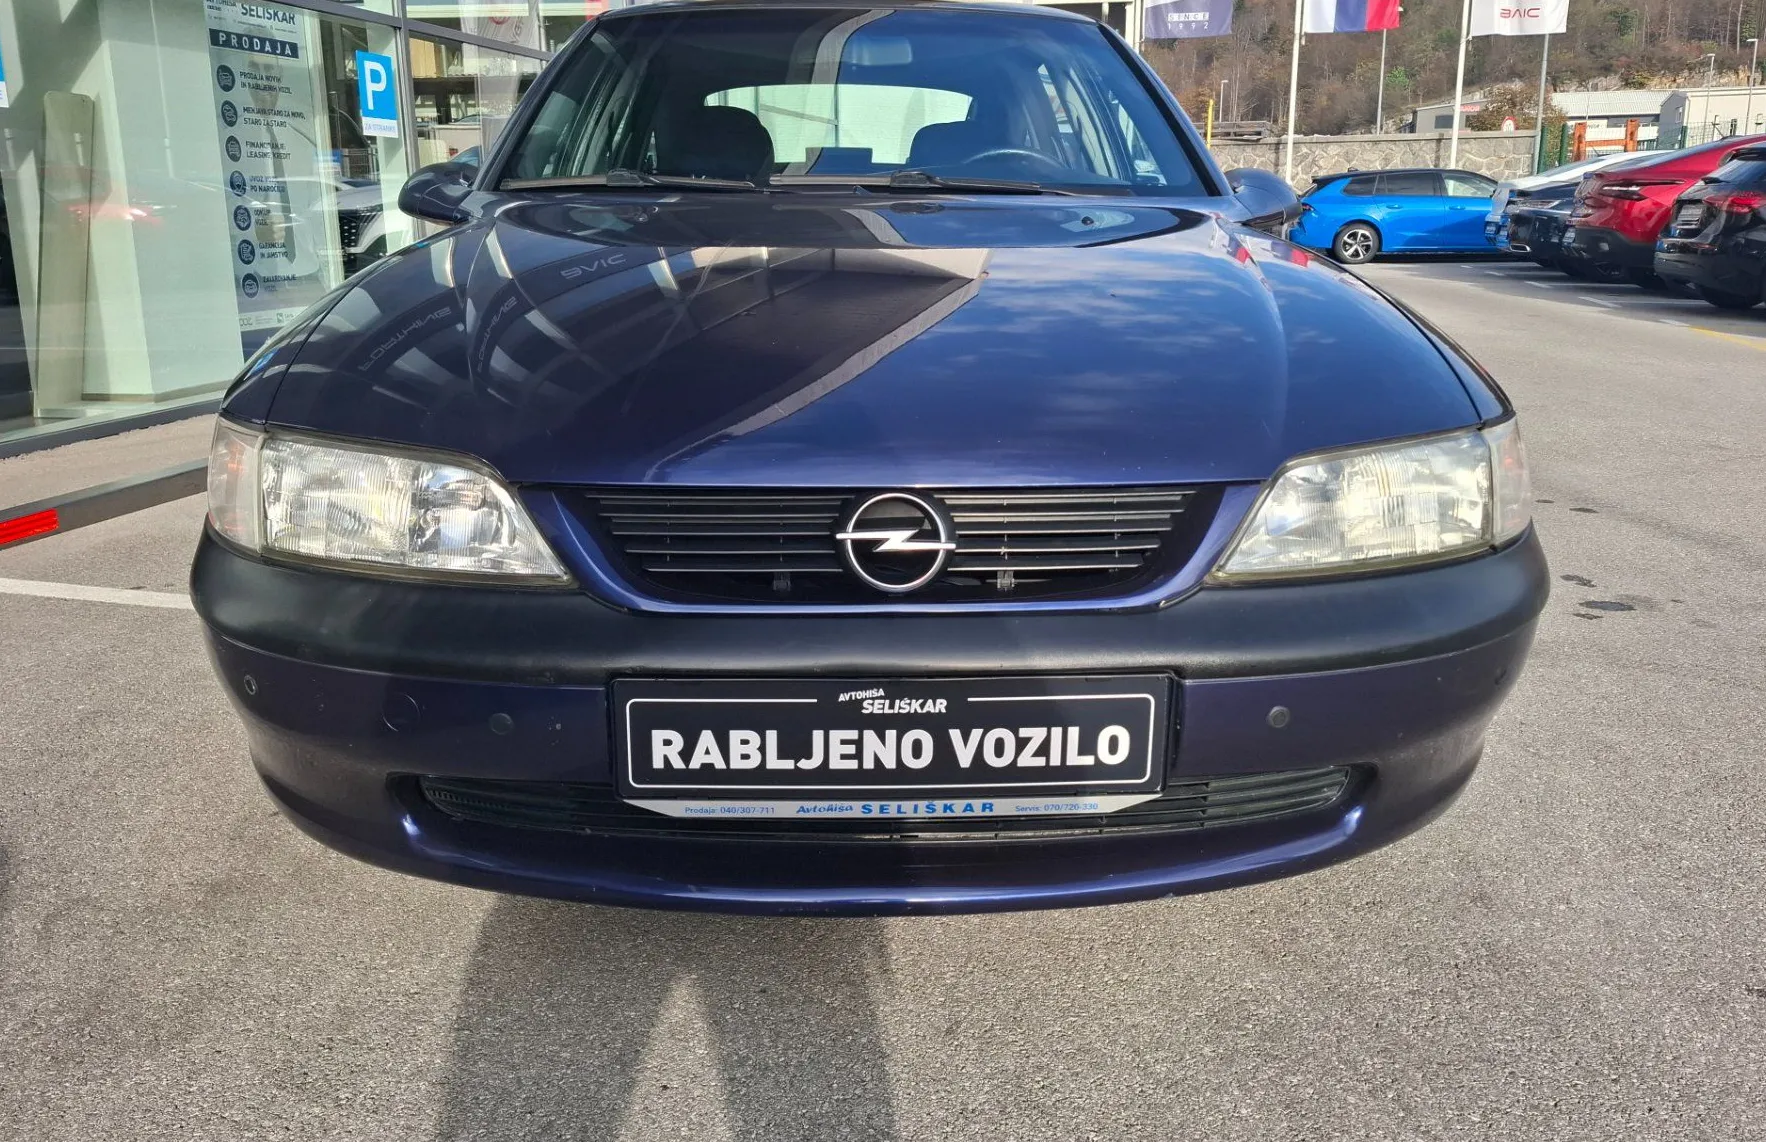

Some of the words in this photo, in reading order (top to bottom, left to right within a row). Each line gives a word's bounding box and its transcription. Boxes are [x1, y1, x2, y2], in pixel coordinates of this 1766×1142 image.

[1168, 12, 1209, 21] SINCE
[1500, 7, 1541, 19] BAIC
[1168, 22, 1209, 30] 1992
[219, 32, 292, 56] PRODAJA
[240, 71, 264, 81] PRODAJA
[363, 60, 387, 111] P
[244, 117, 261, 126] STARO
[838, 688, 885, 702] AVTOHIŠA
[861, 697, 948, 714] SELIŠKAR
[651, 729, 934, 770] RABLJENO
[948, 724, 1131, 768] VOZILO
[861, 800, 995, 815] SELIŠKAR
